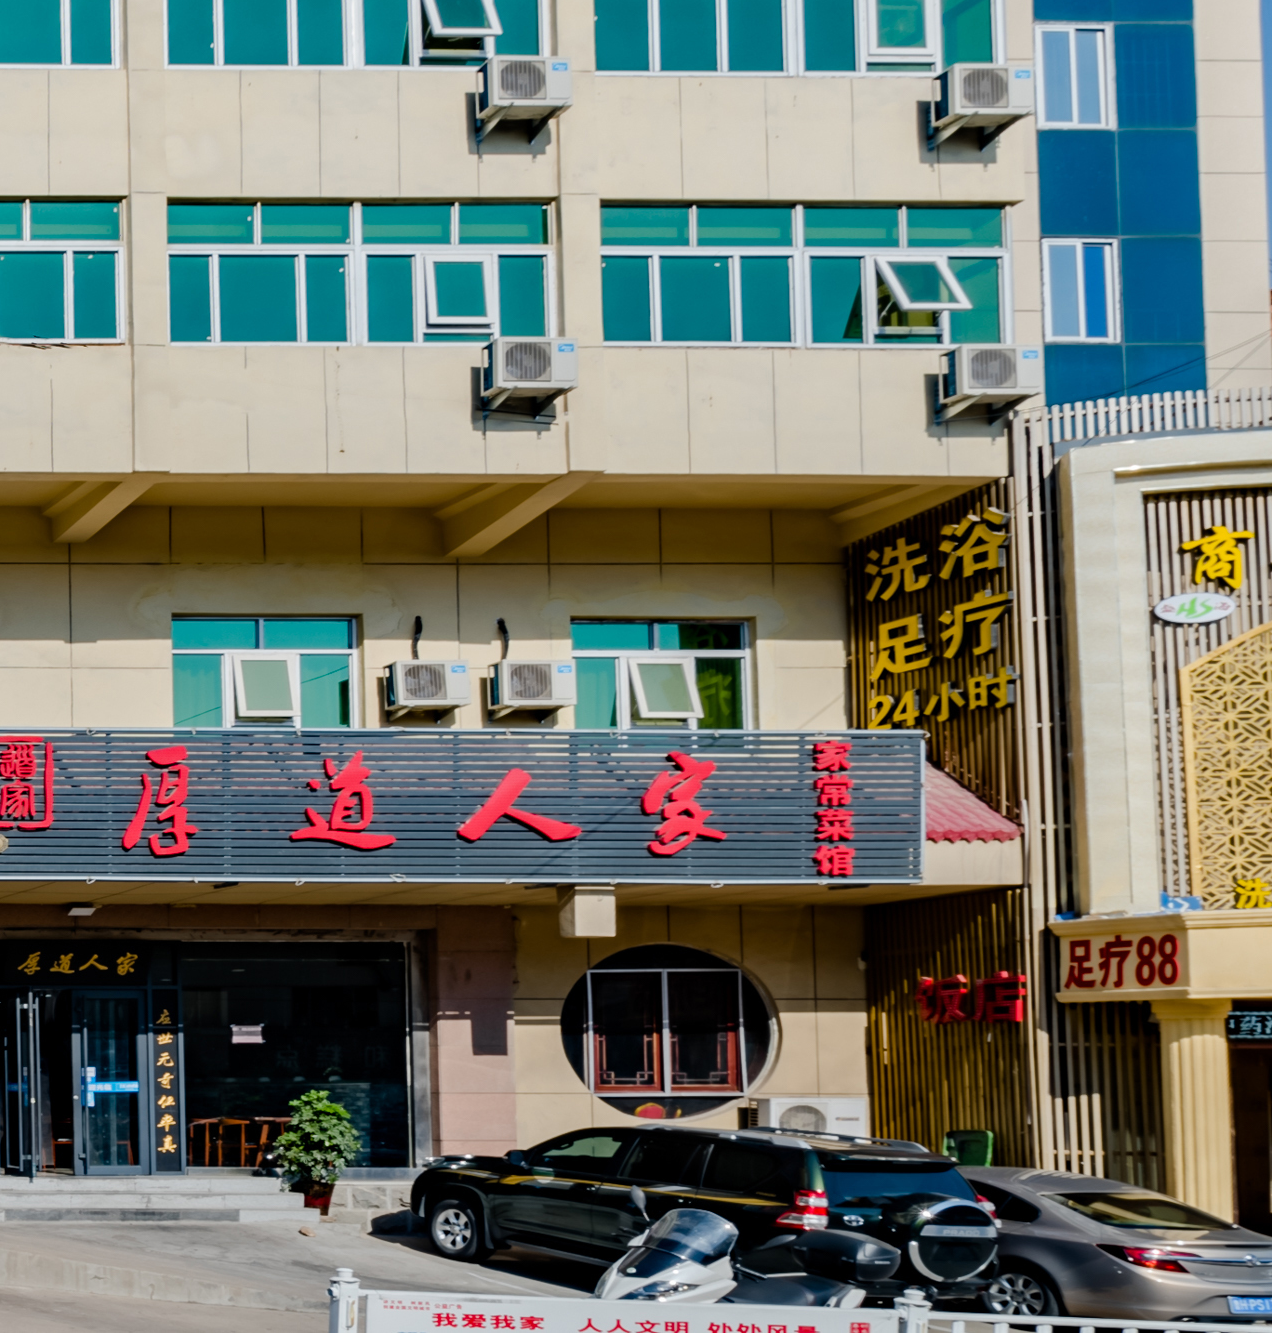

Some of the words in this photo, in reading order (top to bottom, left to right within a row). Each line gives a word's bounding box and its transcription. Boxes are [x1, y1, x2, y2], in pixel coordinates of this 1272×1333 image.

[864, 507, 1013, 602] 洗浴
[869, 589, 1015, 680] 足疗
[867, 665, 1021, 730] 24小时
[122, 745, 727, 857] 厚道人家
[812, 740, 854, 877] 家常菜馆
[1235, 878, 1272, 909] 洗
[17, 951, 139, 976] 厚道人家
[1064, 934, 1180, 989] 足疗88
[915, 970, 1027, 1025] 饭店
[432, 1312, 545, 1330] 我爱我家
[578, 1318, 690, 1333] 人人文明
